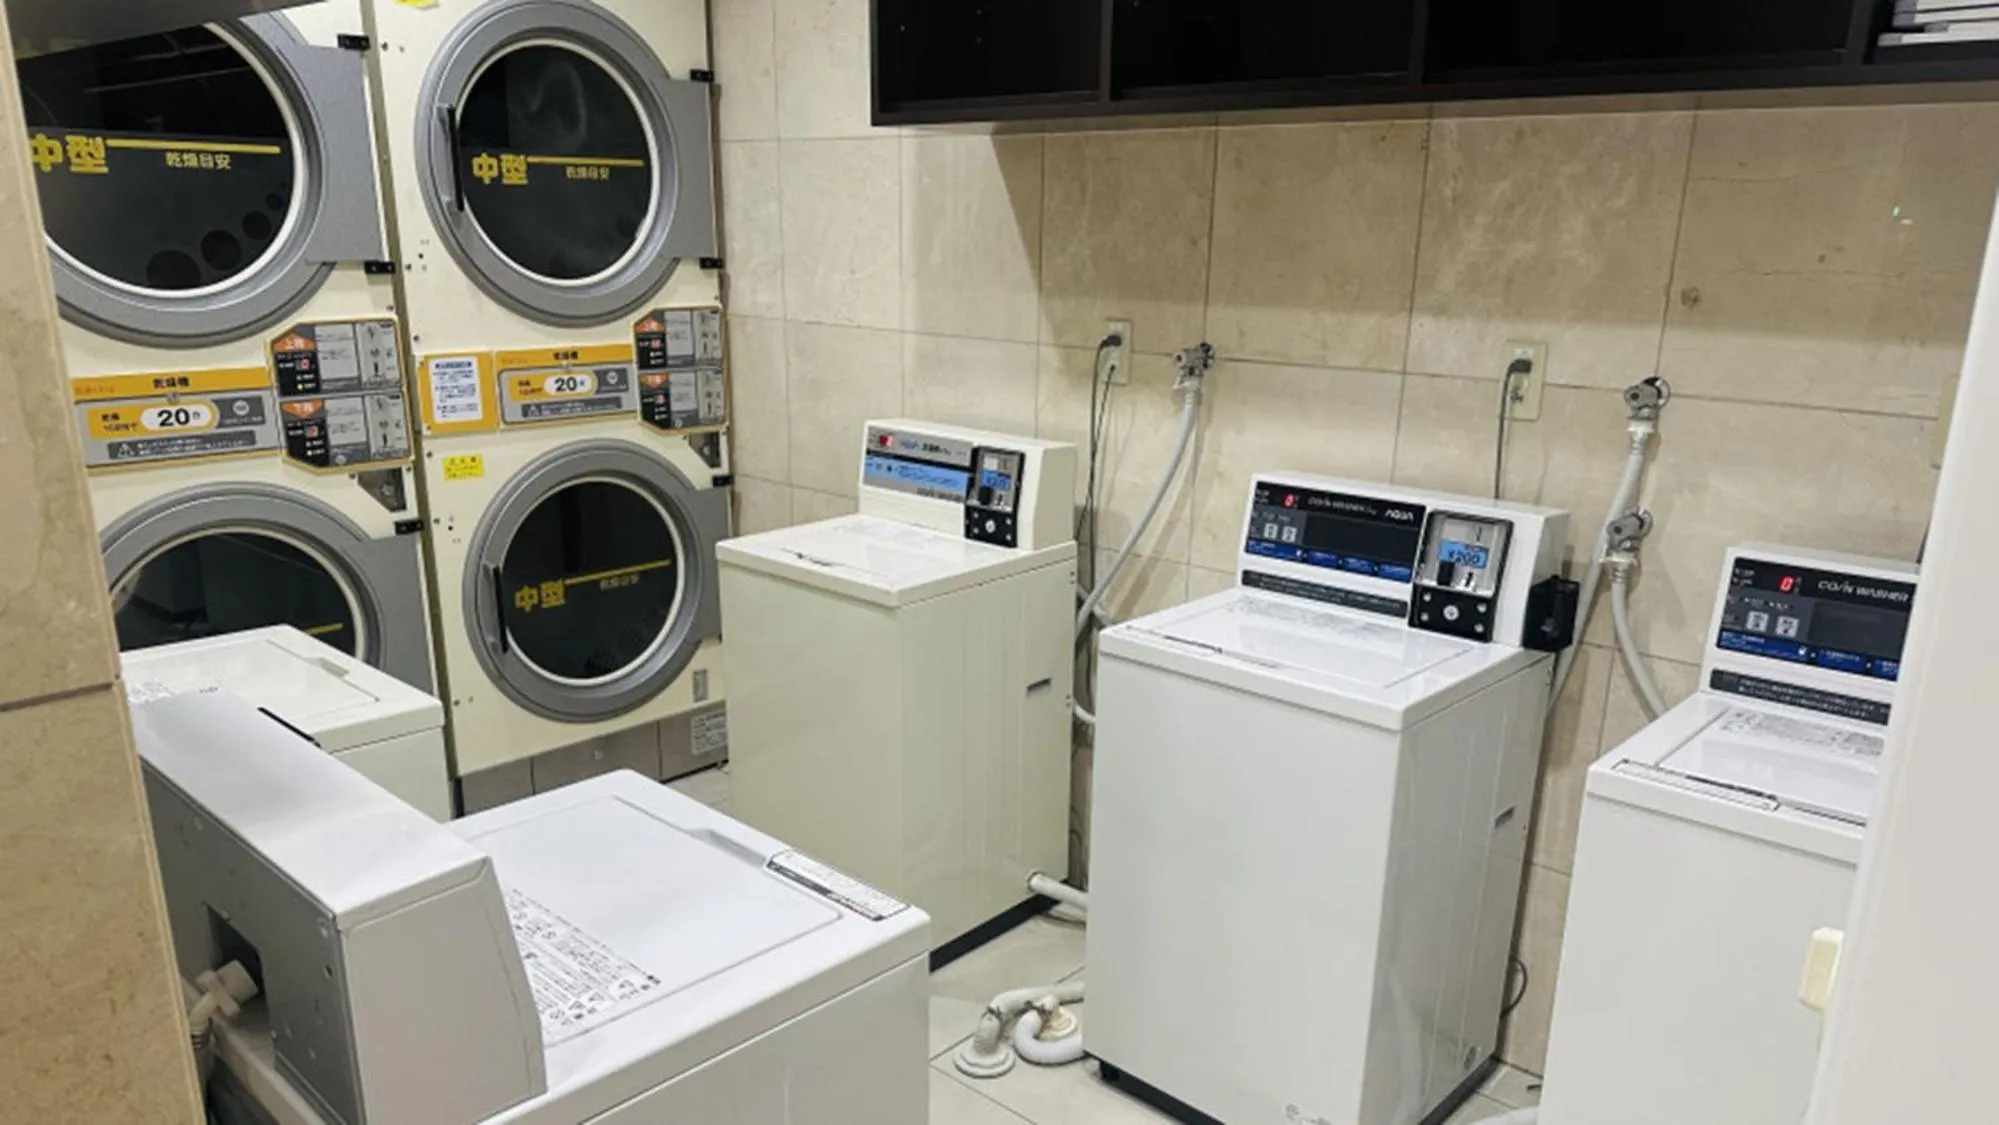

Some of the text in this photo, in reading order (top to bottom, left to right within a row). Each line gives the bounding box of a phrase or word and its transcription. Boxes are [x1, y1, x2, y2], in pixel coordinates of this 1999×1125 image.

[29, 133, 109, 174] 中型
[472, 152, 529, 185] 中型
[554, 376, 578, 392] 20
[156, 408, 190, 428] 20
[1779, 575, 1794, 592] 0
[1817, 580, 1910, 602] COIN WASHER
[515, 578, 565, 613] 中型
